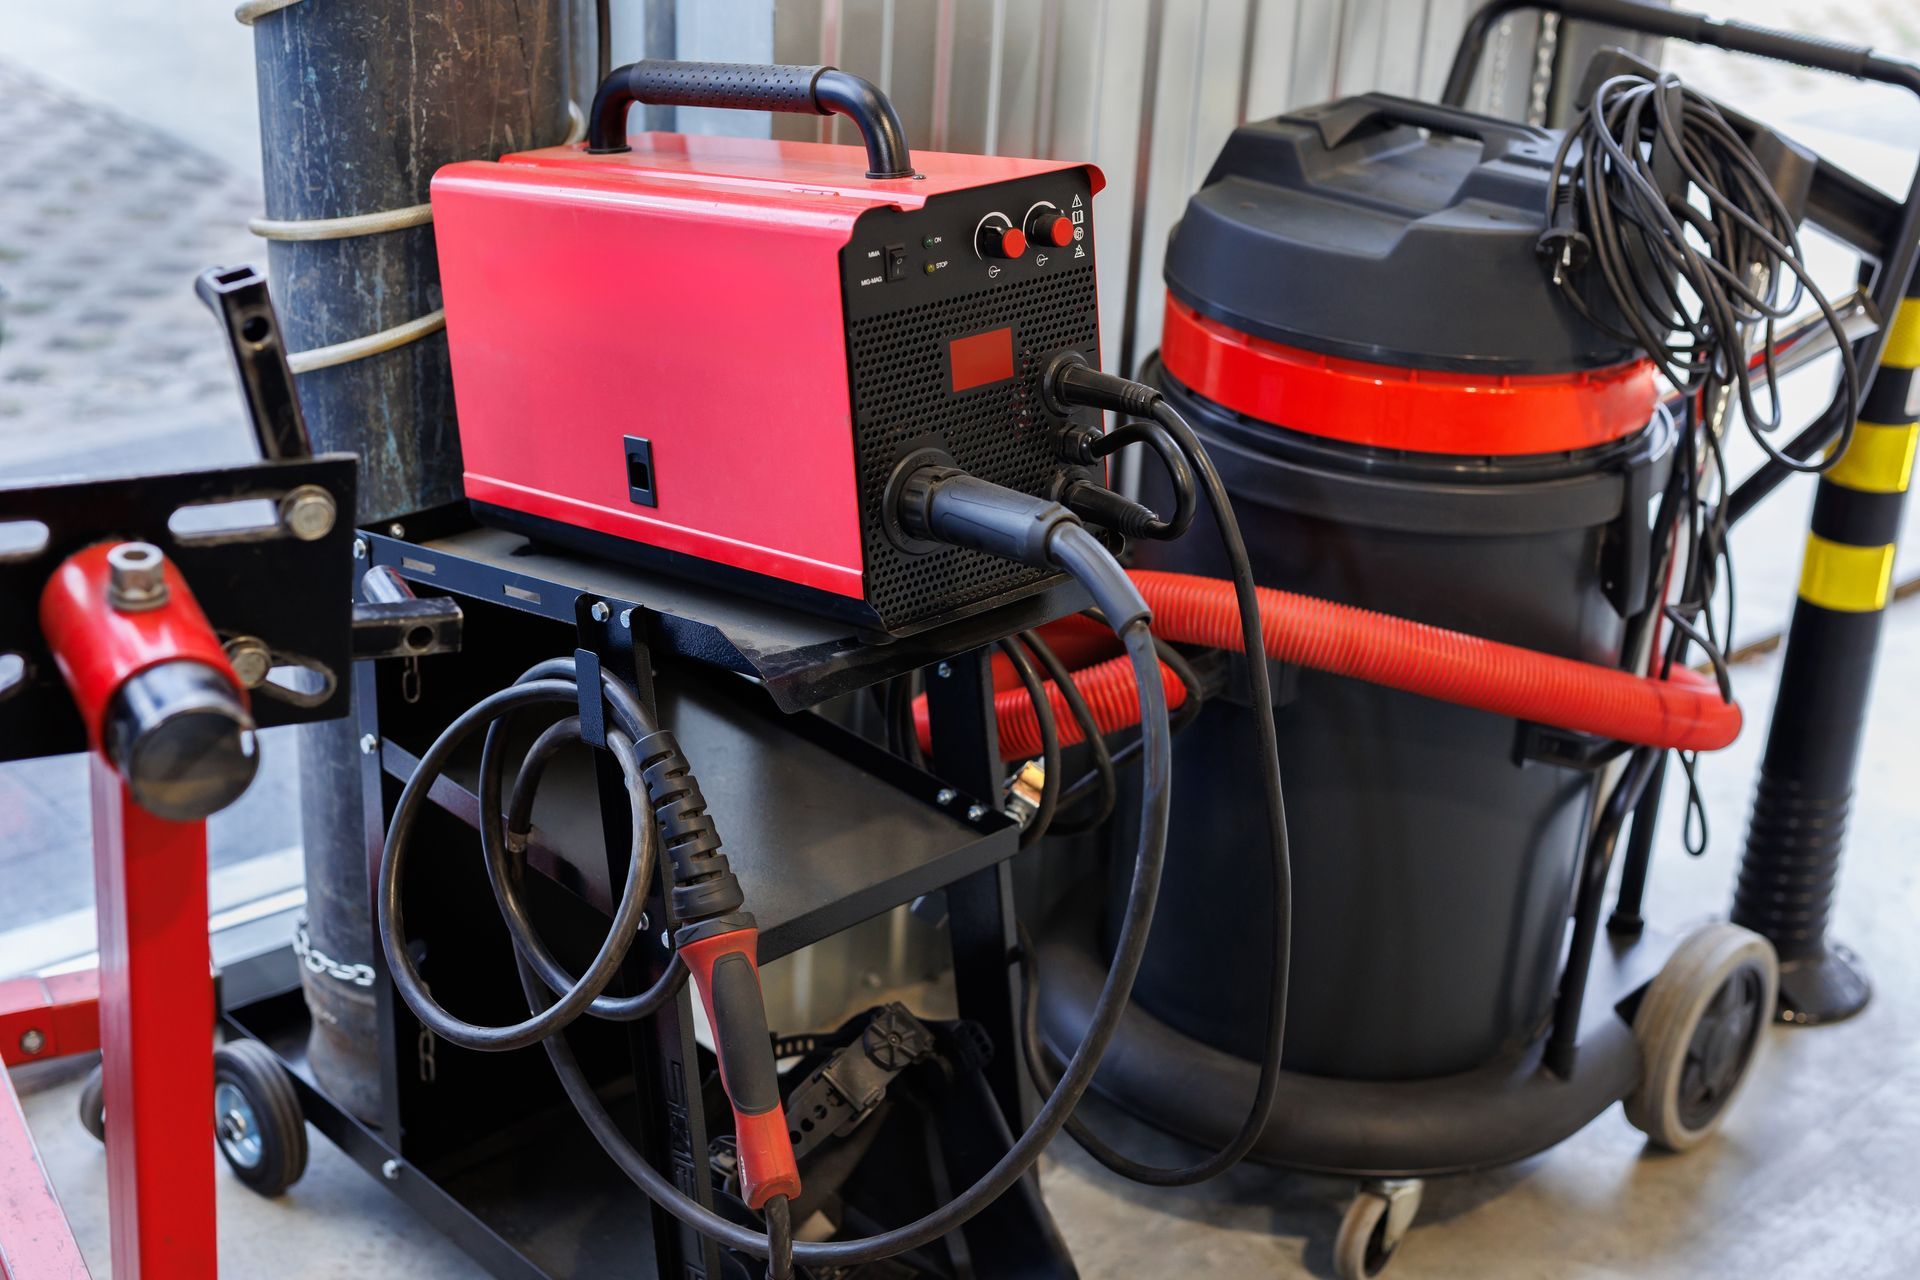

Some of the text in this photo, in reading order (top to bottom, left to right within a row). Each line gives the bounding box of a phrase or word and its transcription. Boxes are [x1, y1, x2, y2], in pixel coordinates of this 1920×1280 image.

[934, 236, 942, 244] ON
[868, 250, 880, 258] MMA
[935, 260, 949, 269] STOP
[860, 275, 883, 287] MIG-MAG
